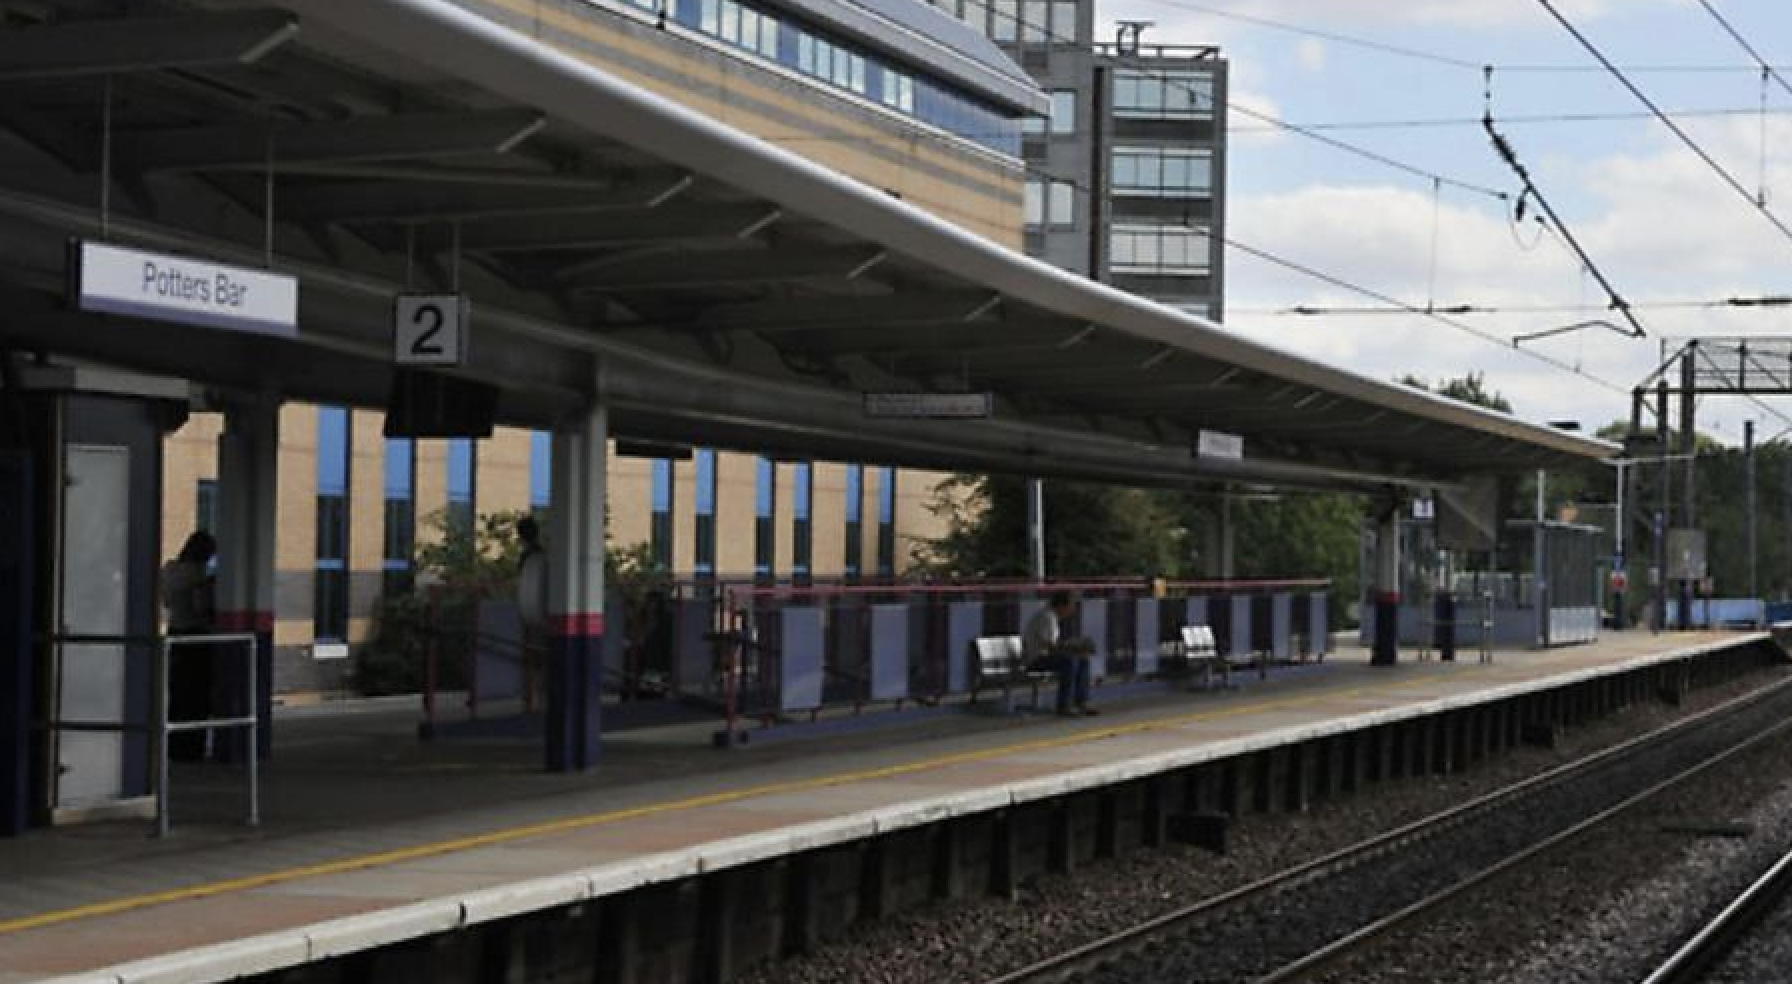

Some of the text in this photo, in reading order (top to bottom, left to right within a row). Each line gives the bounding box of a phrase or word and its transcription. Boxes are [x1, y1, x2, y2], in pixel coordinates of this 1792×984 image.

[142, 261, 247, 307] Potters Bar
[411, 303, 443, 355] 2
